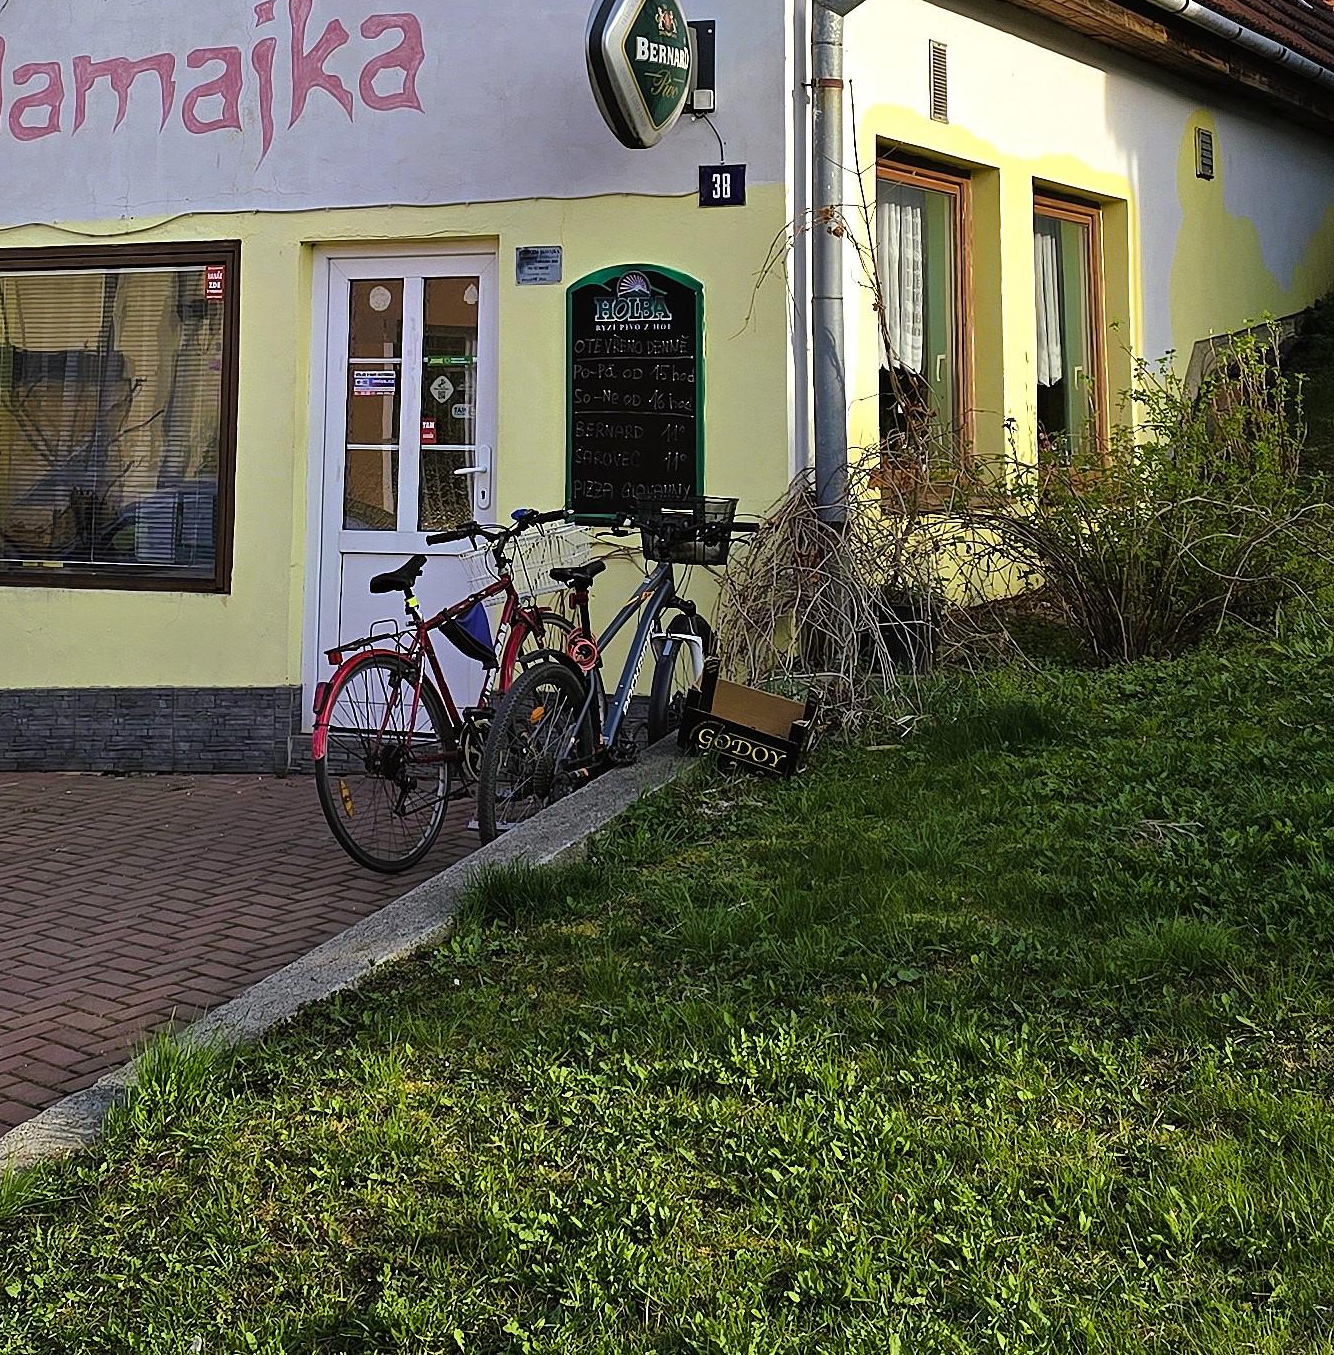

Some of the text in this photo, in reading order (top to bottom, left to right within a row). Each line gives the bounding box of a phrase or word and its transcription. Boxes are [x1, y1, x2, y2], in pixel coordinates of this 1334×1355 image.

[635, 36, 689, 70] BERNARD
[712, 173, 731, 199] 38
[594, 296, 673, 322] HOLBA
[574, 420, 645, 439] BERNARD
[573, 479, 614, 501] PIZZA
[698, 728, 787, 768] GODOY
